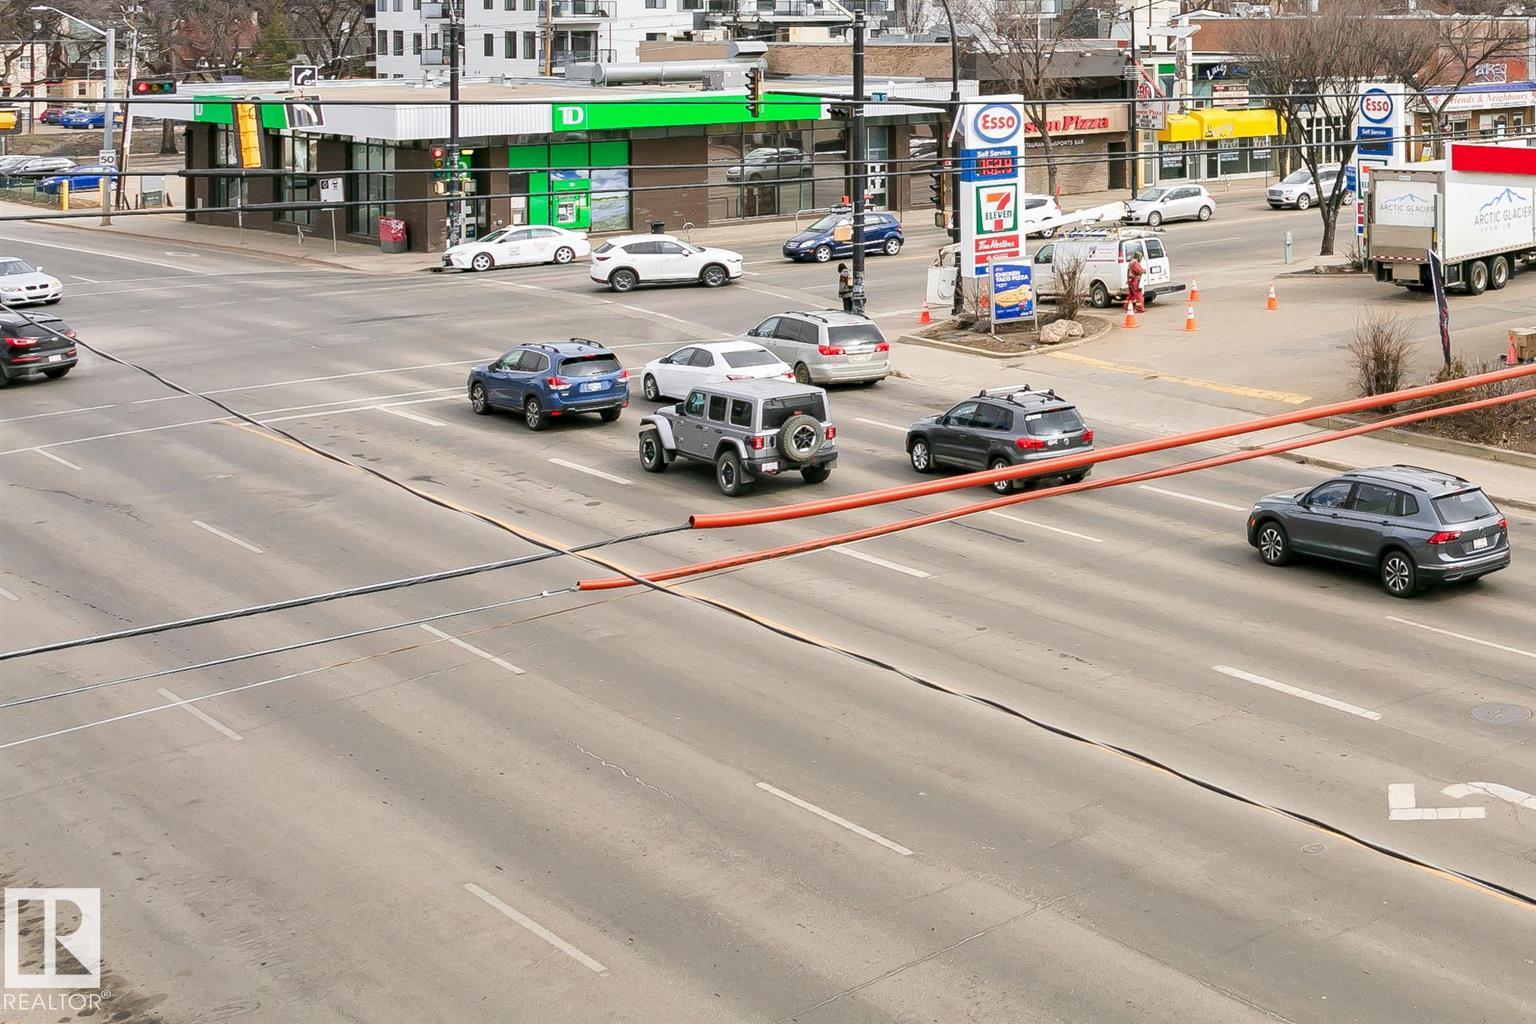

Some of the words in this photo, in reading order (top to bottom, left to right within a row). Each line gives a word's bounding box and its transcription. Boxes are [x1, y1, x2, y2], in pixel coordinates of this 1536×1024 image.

[557, 106, 584, 125] TD
[1062, 115, 1109, 131] Pizza
[101, 155, 114, 164] 50
[986, 191, 1011, 231] 7
[1379, 204, 1404, 212] ARCTIC
[1406, 204, 1435, 213] GLACIER
[1474, 211, 1501, 226] ARCTIC
[1503, 206, 1533, 221] GLACIER
[978, 238, 990, 250] Tim
[990, 239, 1015, 249] Hortons
